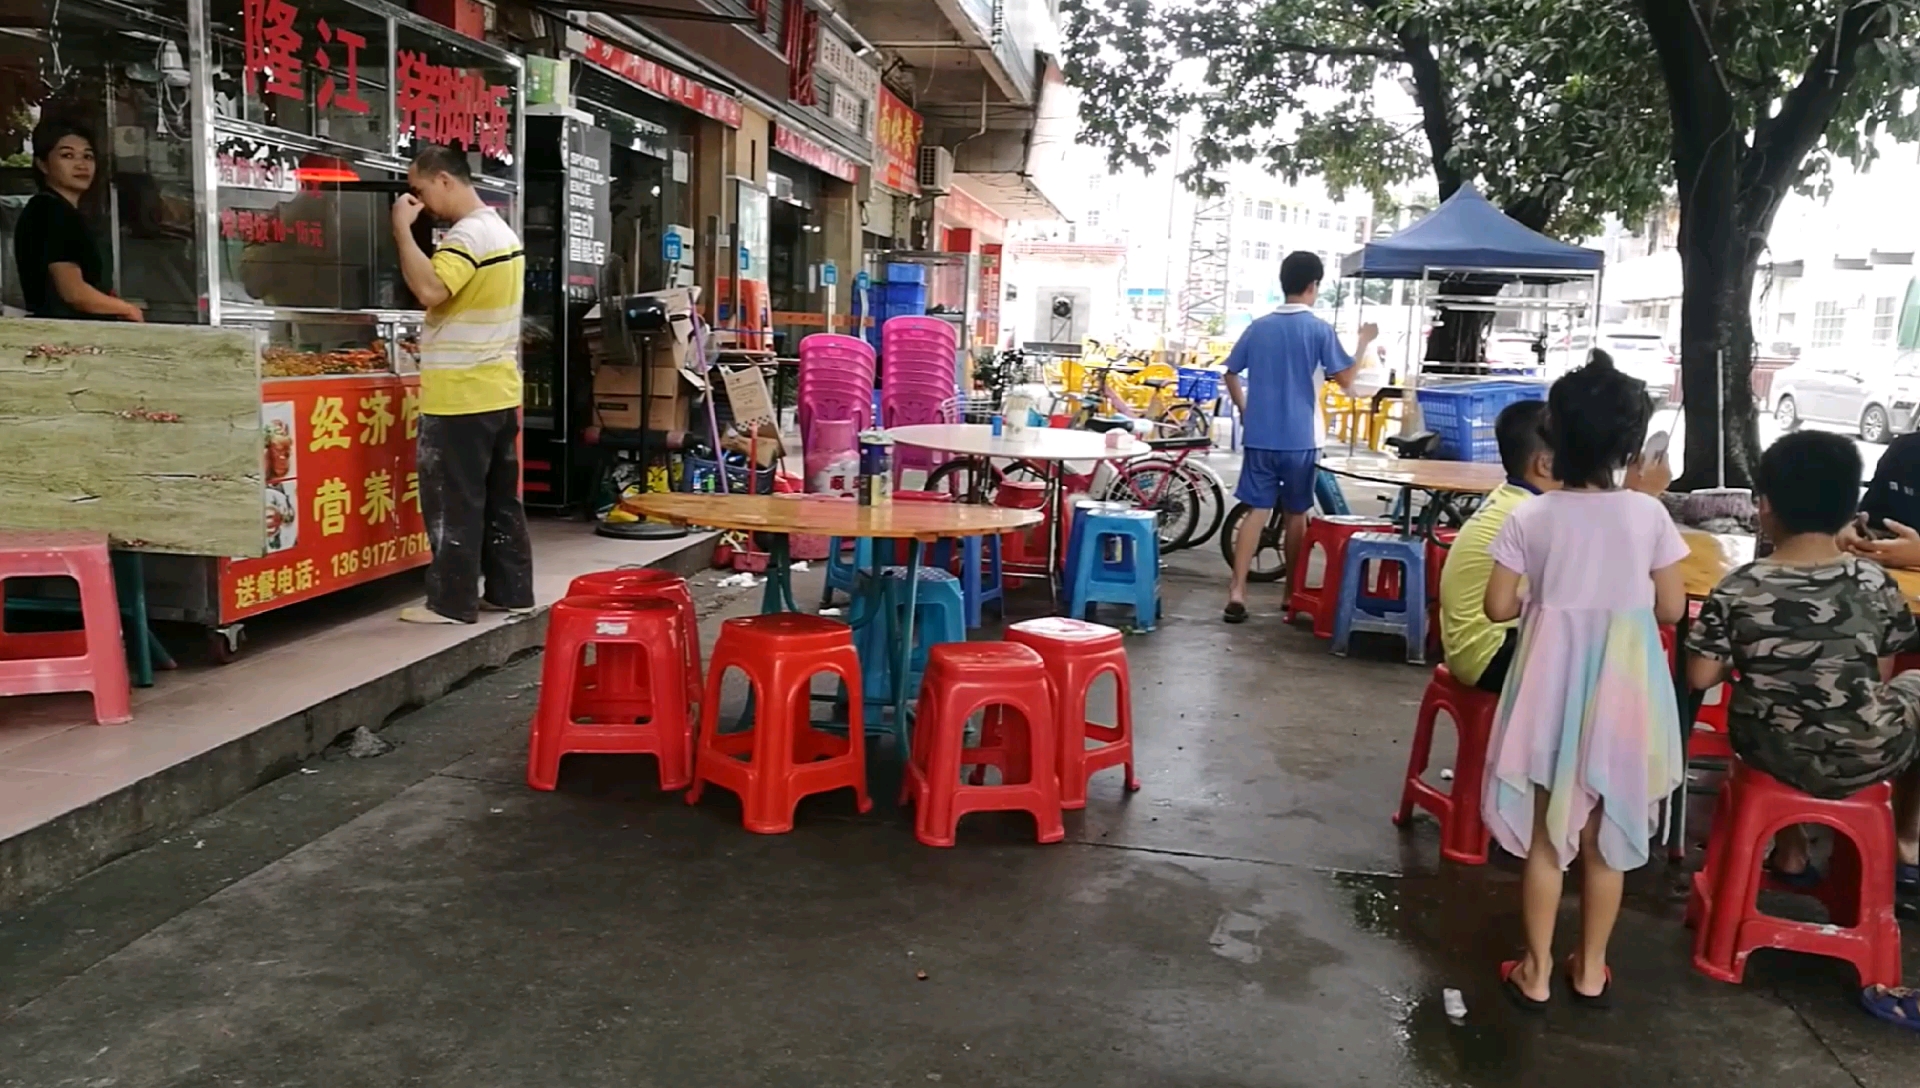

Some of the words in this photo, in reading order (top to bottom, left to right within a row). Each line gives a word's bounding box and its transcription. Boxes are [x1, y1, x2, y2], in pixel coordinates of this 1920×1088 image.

[244, 0, 370, 114] 隆江
[397, 48, 513, 160] 猪脚饭
[569, 152, 600, 171] SPORTS
[569, 180, 592, 196] ENCE
[569, 194, 595, 210] STORE
[569, 211, 594, 239] 运动
[569, 236, 605, 266] 智能店
[331, 549, 359, 578] 136
[362, 540, 397, 569] 9172
